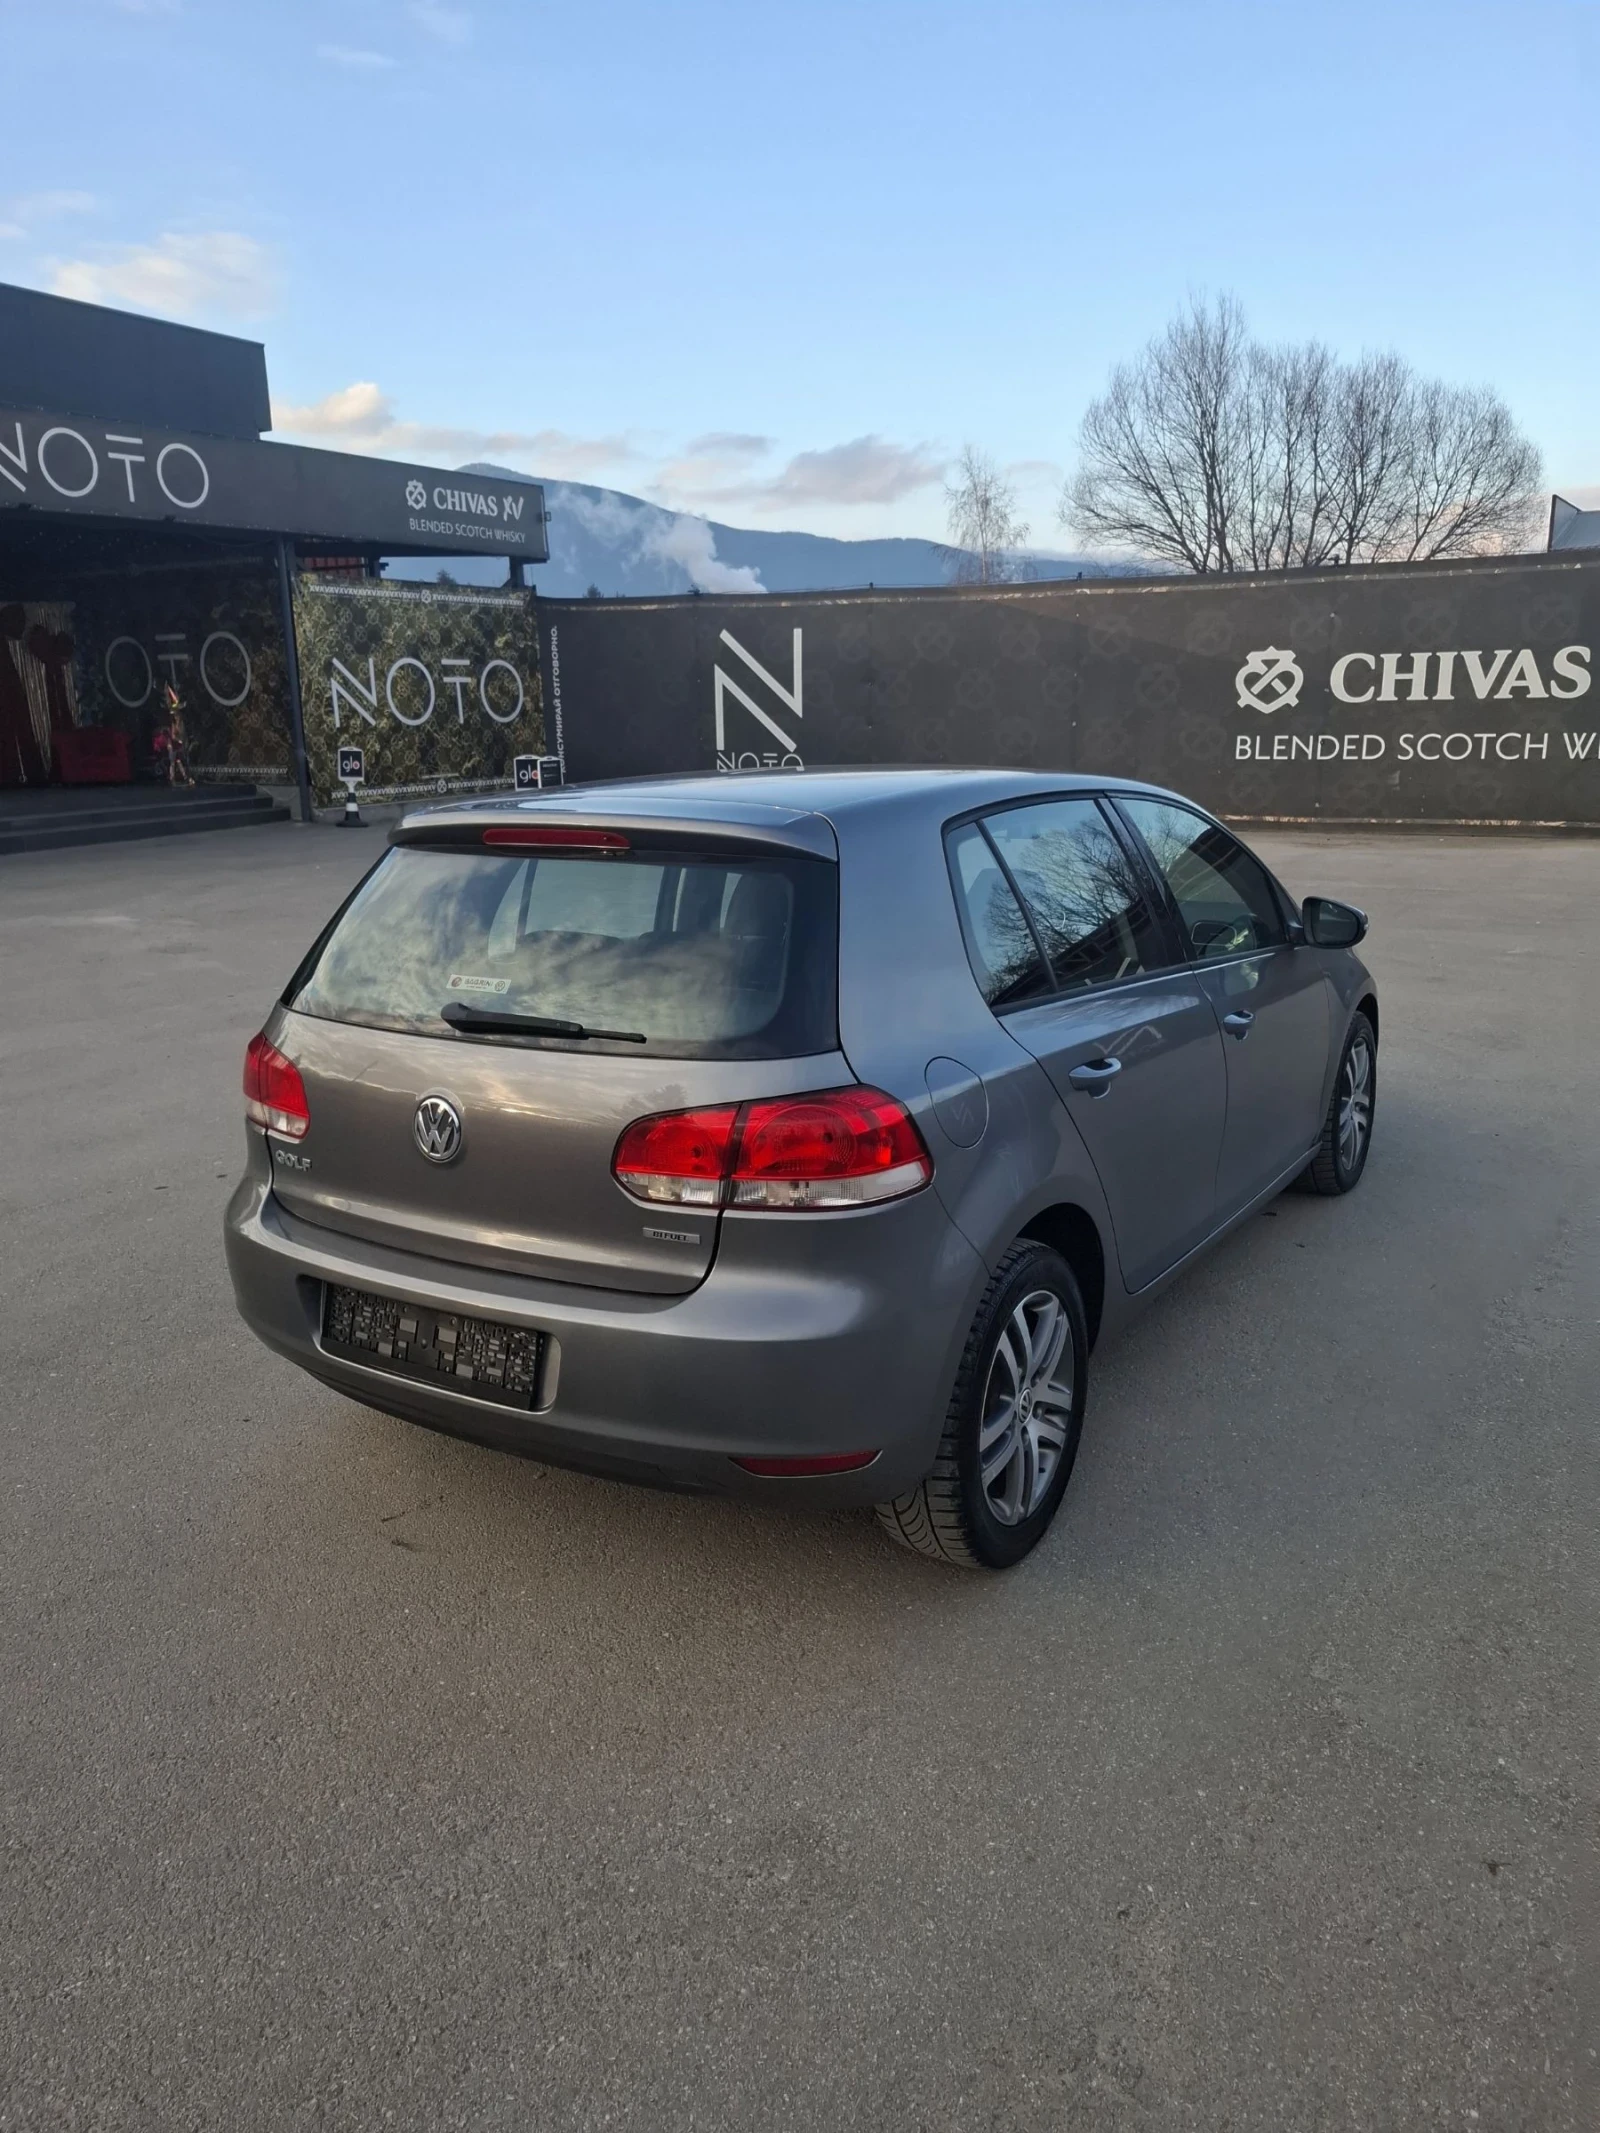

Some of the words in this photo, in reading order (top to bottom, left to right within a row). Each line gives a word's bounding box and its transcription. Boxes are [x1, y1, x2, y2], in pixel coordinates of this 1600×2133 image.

[433, 487, 498, 517] CHIVAS
[503, 495, 524, 522] XV
[409, 518, 454, 535] BLENDED
[455, 523, 493, 540] SCOTCH
[494, 529, 526, 544] WHISKY
[550, 625, 561, 697] ОТГОВОРНО.
[1330, 645, 1592, 703] CHIVAS
[330, 657, 524, 728] NOTO
[714, 628, 803, 752] N
[1235, 734, 1385, 760] BLENDED
[1397, 732, 1549, 760] SCOTCH
[1563, 732, 1600, 760] W
[342, 755, 360, 773] glo
[275, 1149, 312, 1172] GOLF
